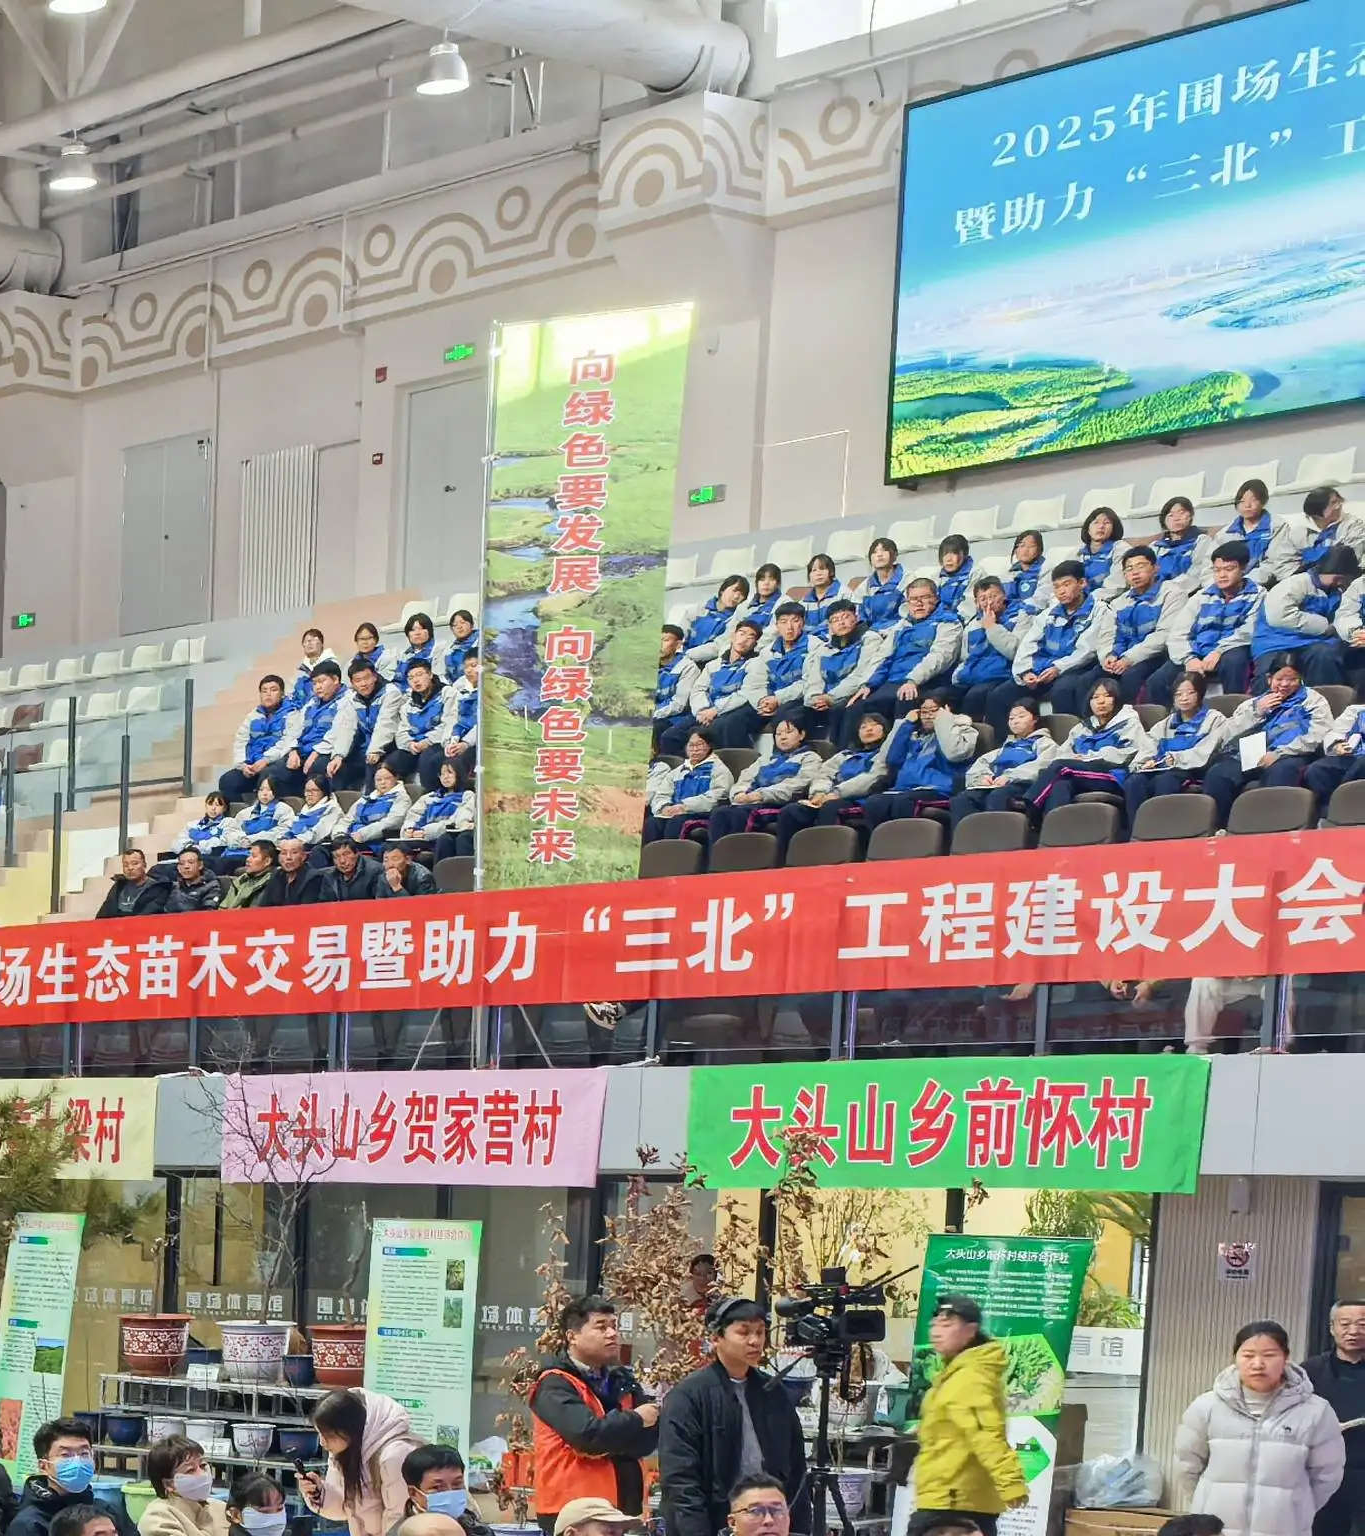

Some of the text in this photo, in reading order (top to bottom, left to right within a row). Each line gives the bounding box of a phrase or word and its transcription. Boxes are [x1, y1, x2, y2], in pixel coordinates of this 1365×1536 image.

[527, 348, 616, 864] 向绿色要发展 向绿色要未来
[257, 1086, 563, 1167] 大头山乡贺家营村
[729, 1075, 1152, 1171] 大头山乡前怀村
